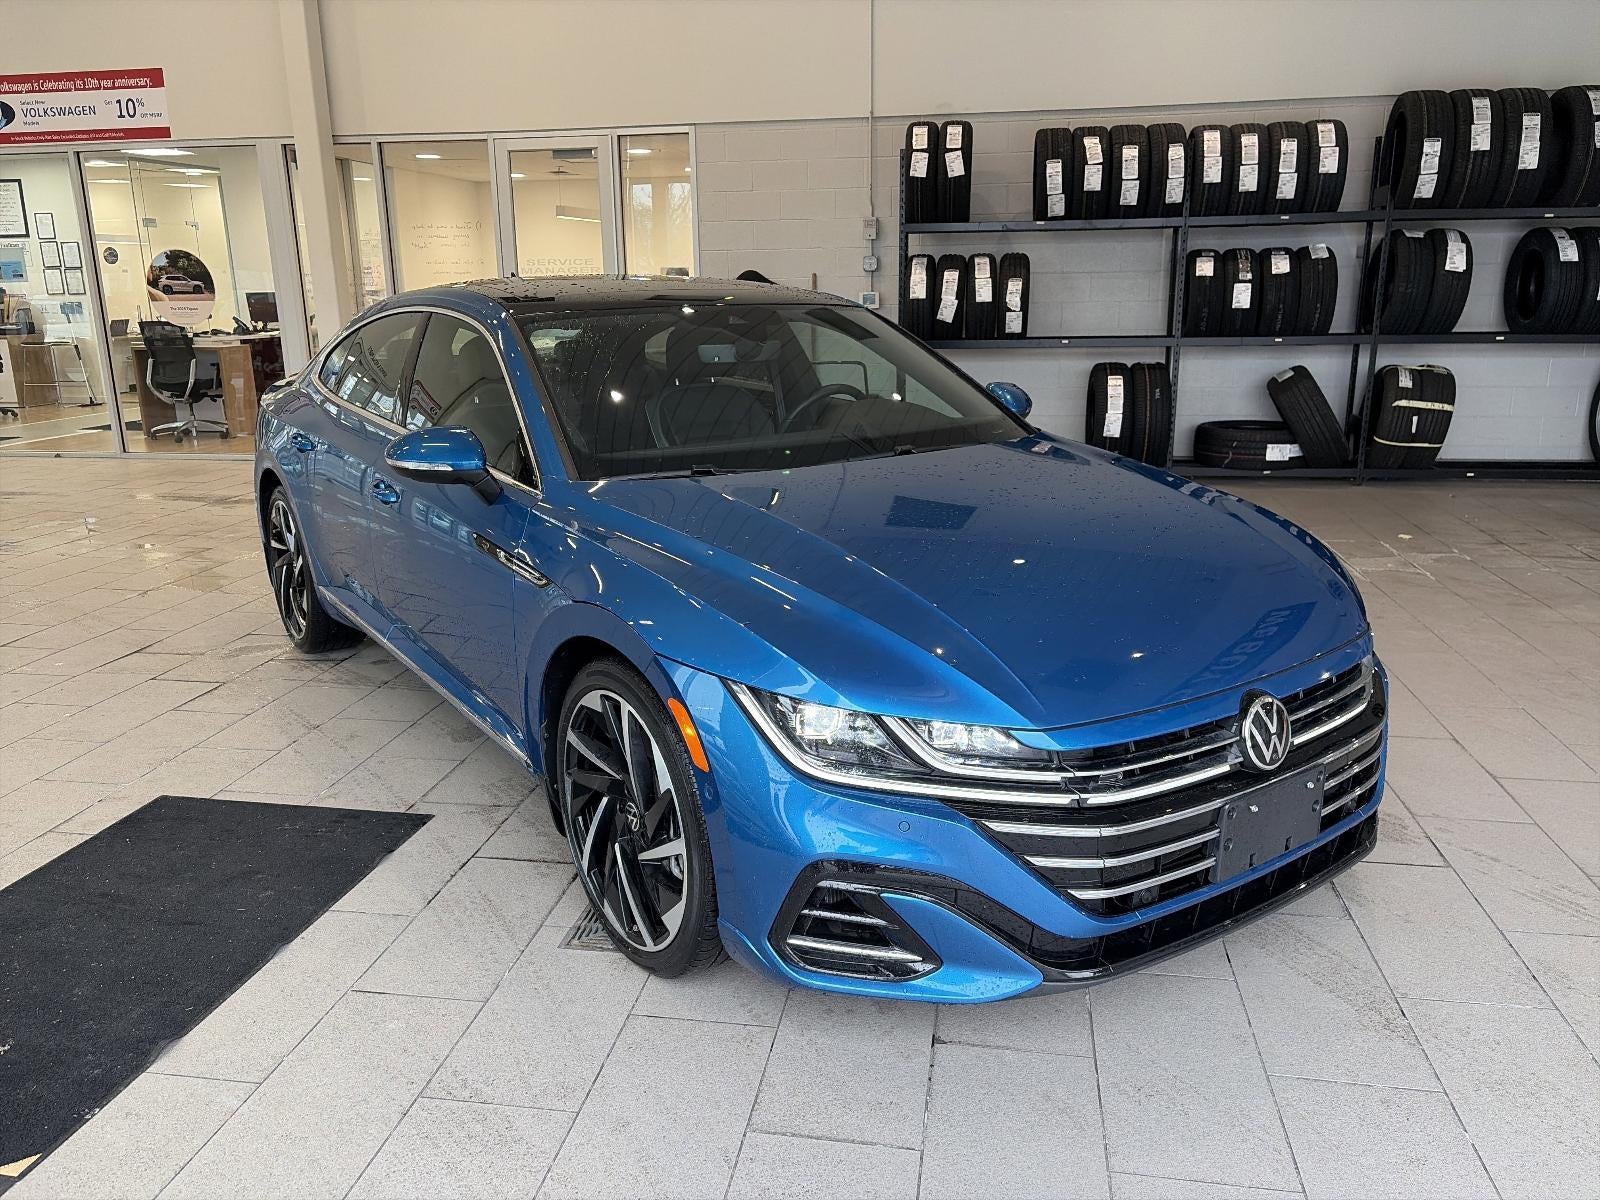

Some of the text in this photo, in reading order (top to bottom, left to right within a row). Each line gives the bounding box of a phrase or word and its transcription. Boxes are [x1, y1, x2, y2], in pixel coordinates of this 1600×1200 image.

[0, 81, 32, 93] olkswagen
[32, 79, 39, 91] is
[39, 78, 75, 92] Celebrating
[84, 77, 100, 89] 10th
[100, 79, 114, 91] year
[114, 75, 153, 88] anniversary.
[21, 105, 96, 118] VOLKSWAGEN
[521, 266, 600, 274] MANAGER
